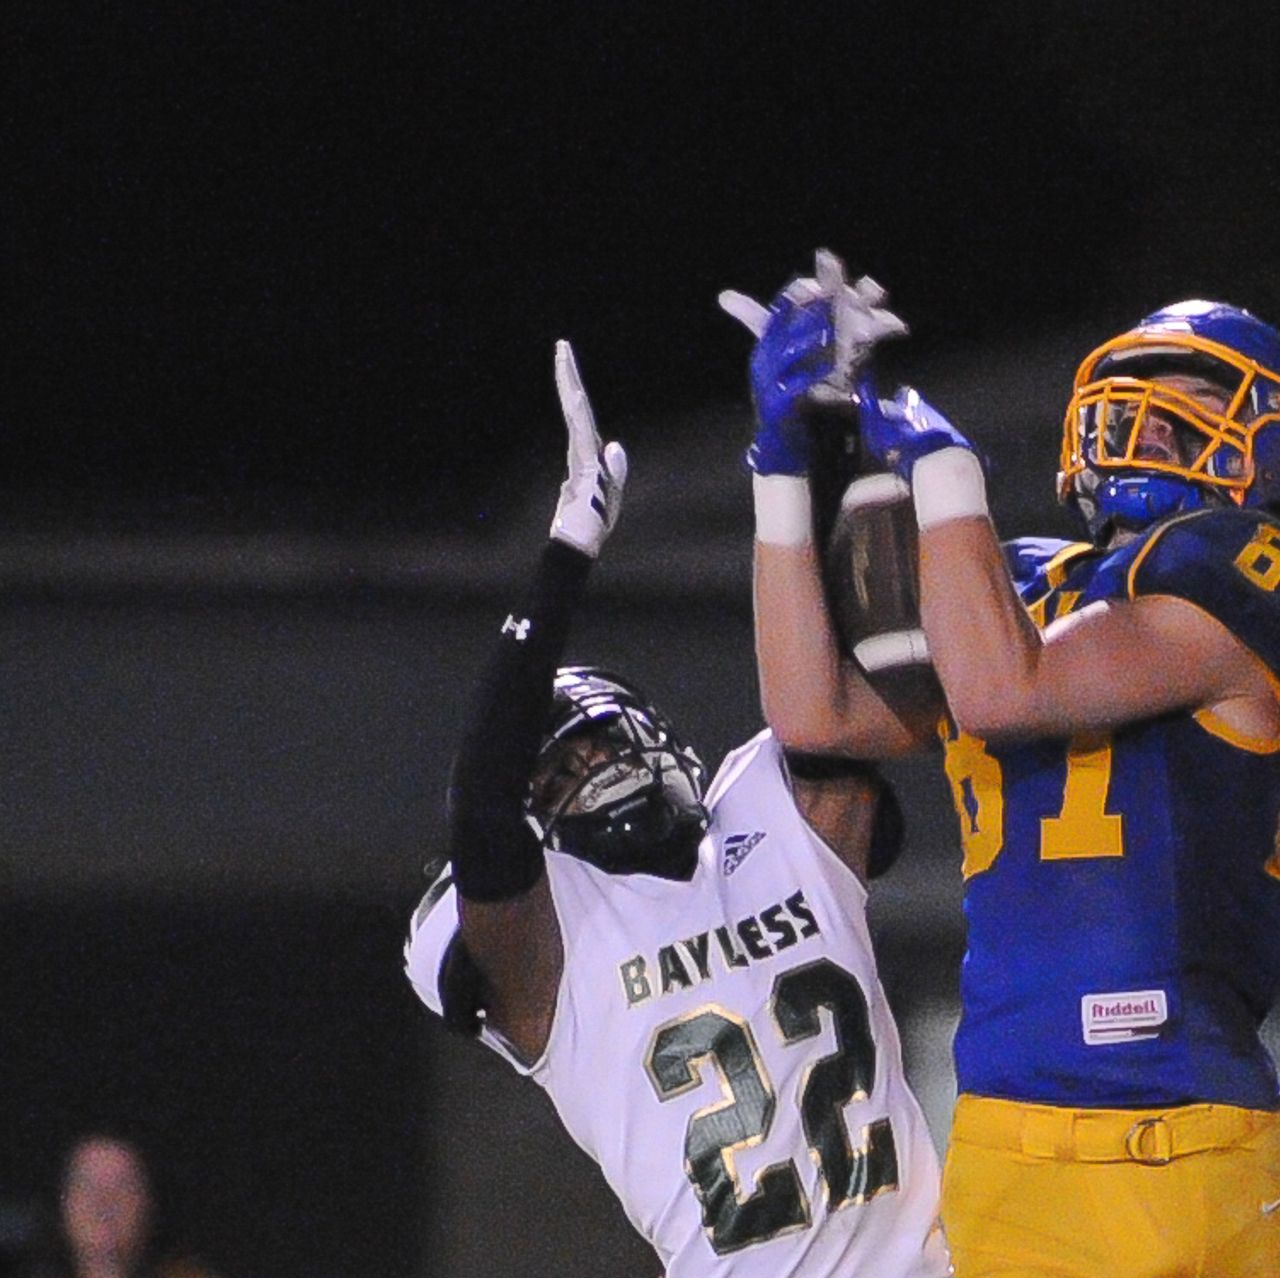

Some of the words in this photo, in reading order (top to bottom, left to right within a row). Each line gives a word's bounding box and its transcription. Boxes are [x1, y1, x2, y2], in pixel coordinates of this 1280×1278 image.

[620, 888, 820, 1007] BAYLESS
[1091, 999, 1158, 1018] Riddell
[642, 956, 900, 1256] 22
